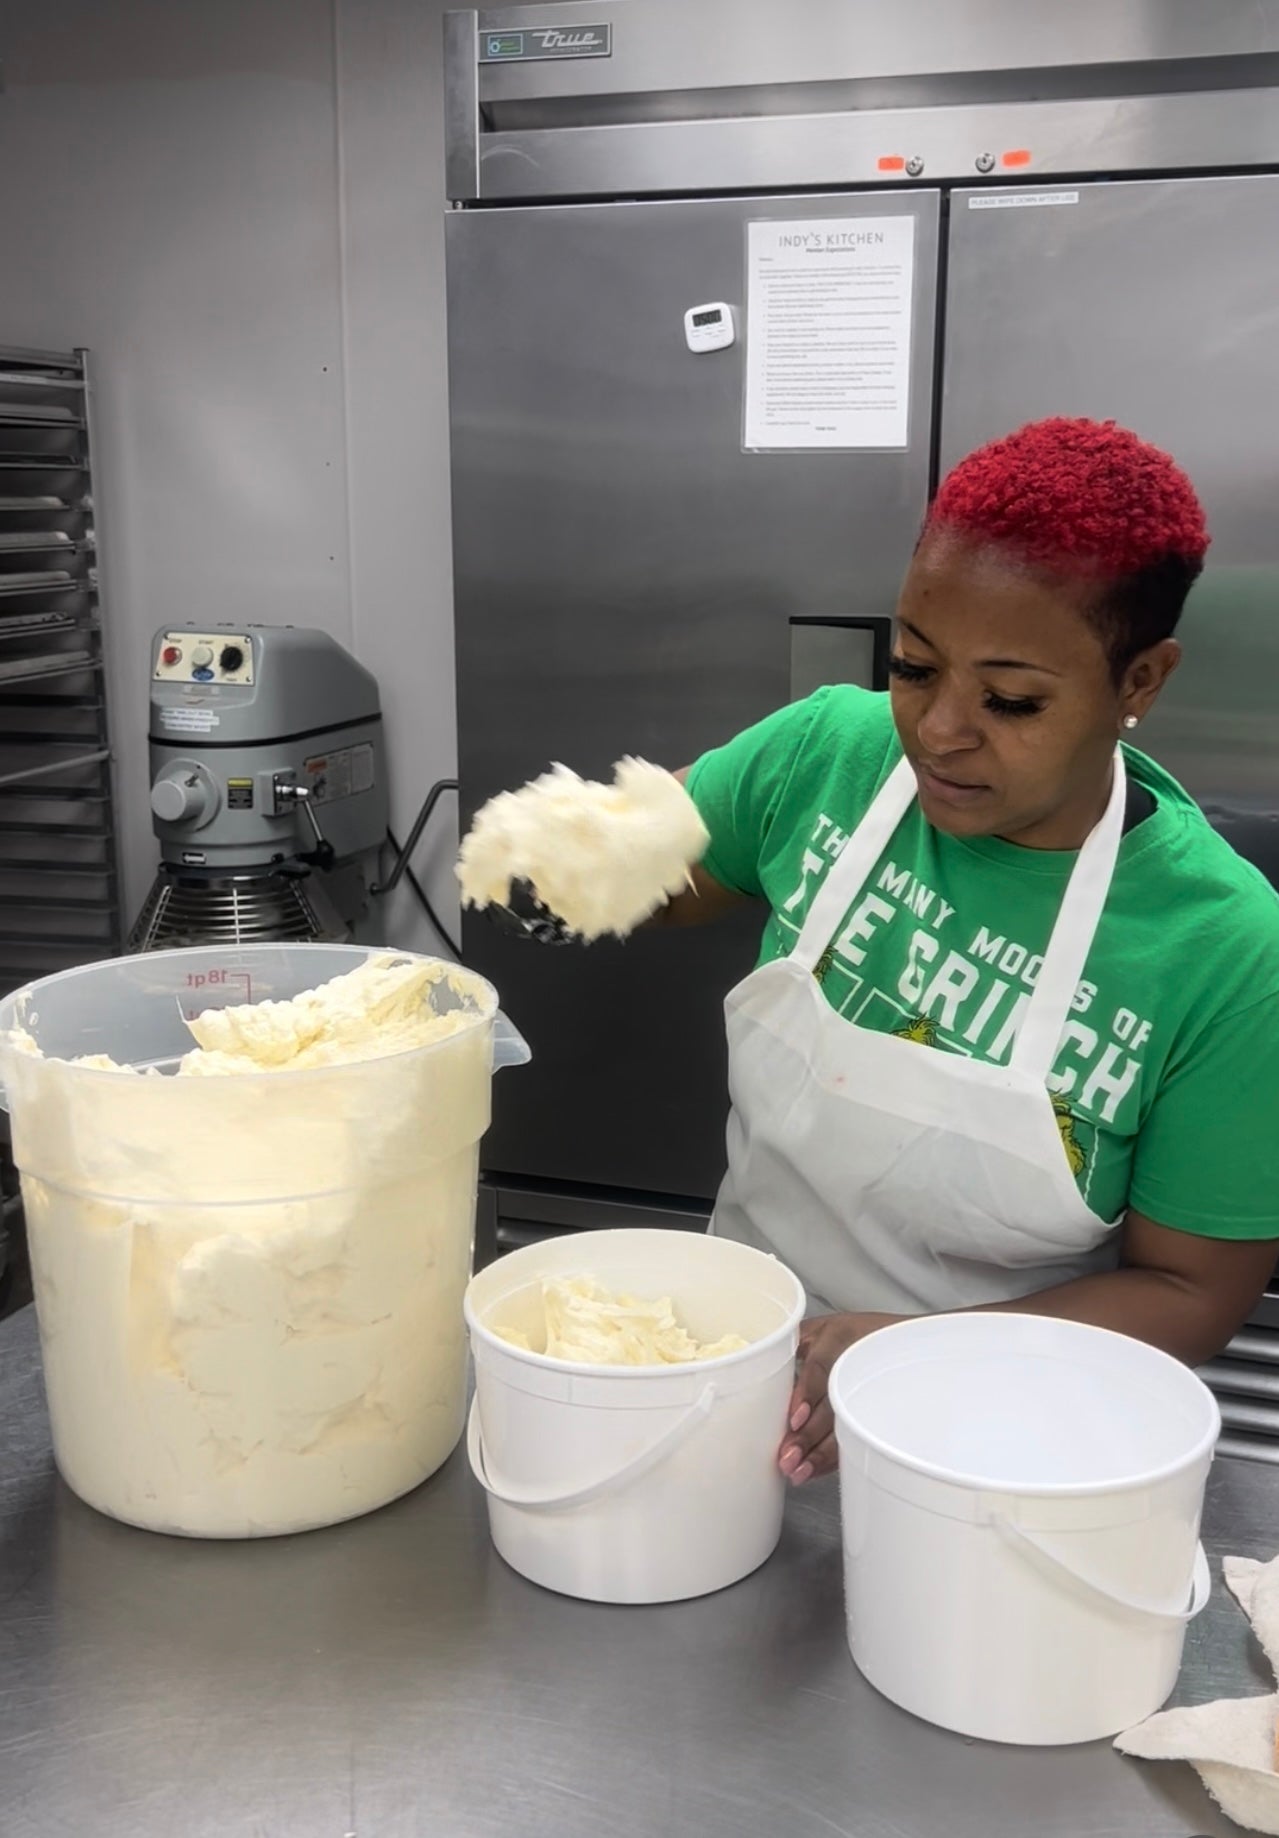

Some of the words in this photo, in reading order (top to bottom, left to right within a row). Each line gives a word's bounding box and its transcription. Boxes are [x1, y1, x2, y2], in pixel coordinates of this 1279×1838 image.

[779, 232, 821, 247] INDY'S
[826, 232, 884, 246] KITCHEN
[783, 846, 897, 967] TE
[811, 812, 850, 859] TH
[967, 925, 1099, 1013] MOOS
[1112, 1007, 1153, 1051] OF
